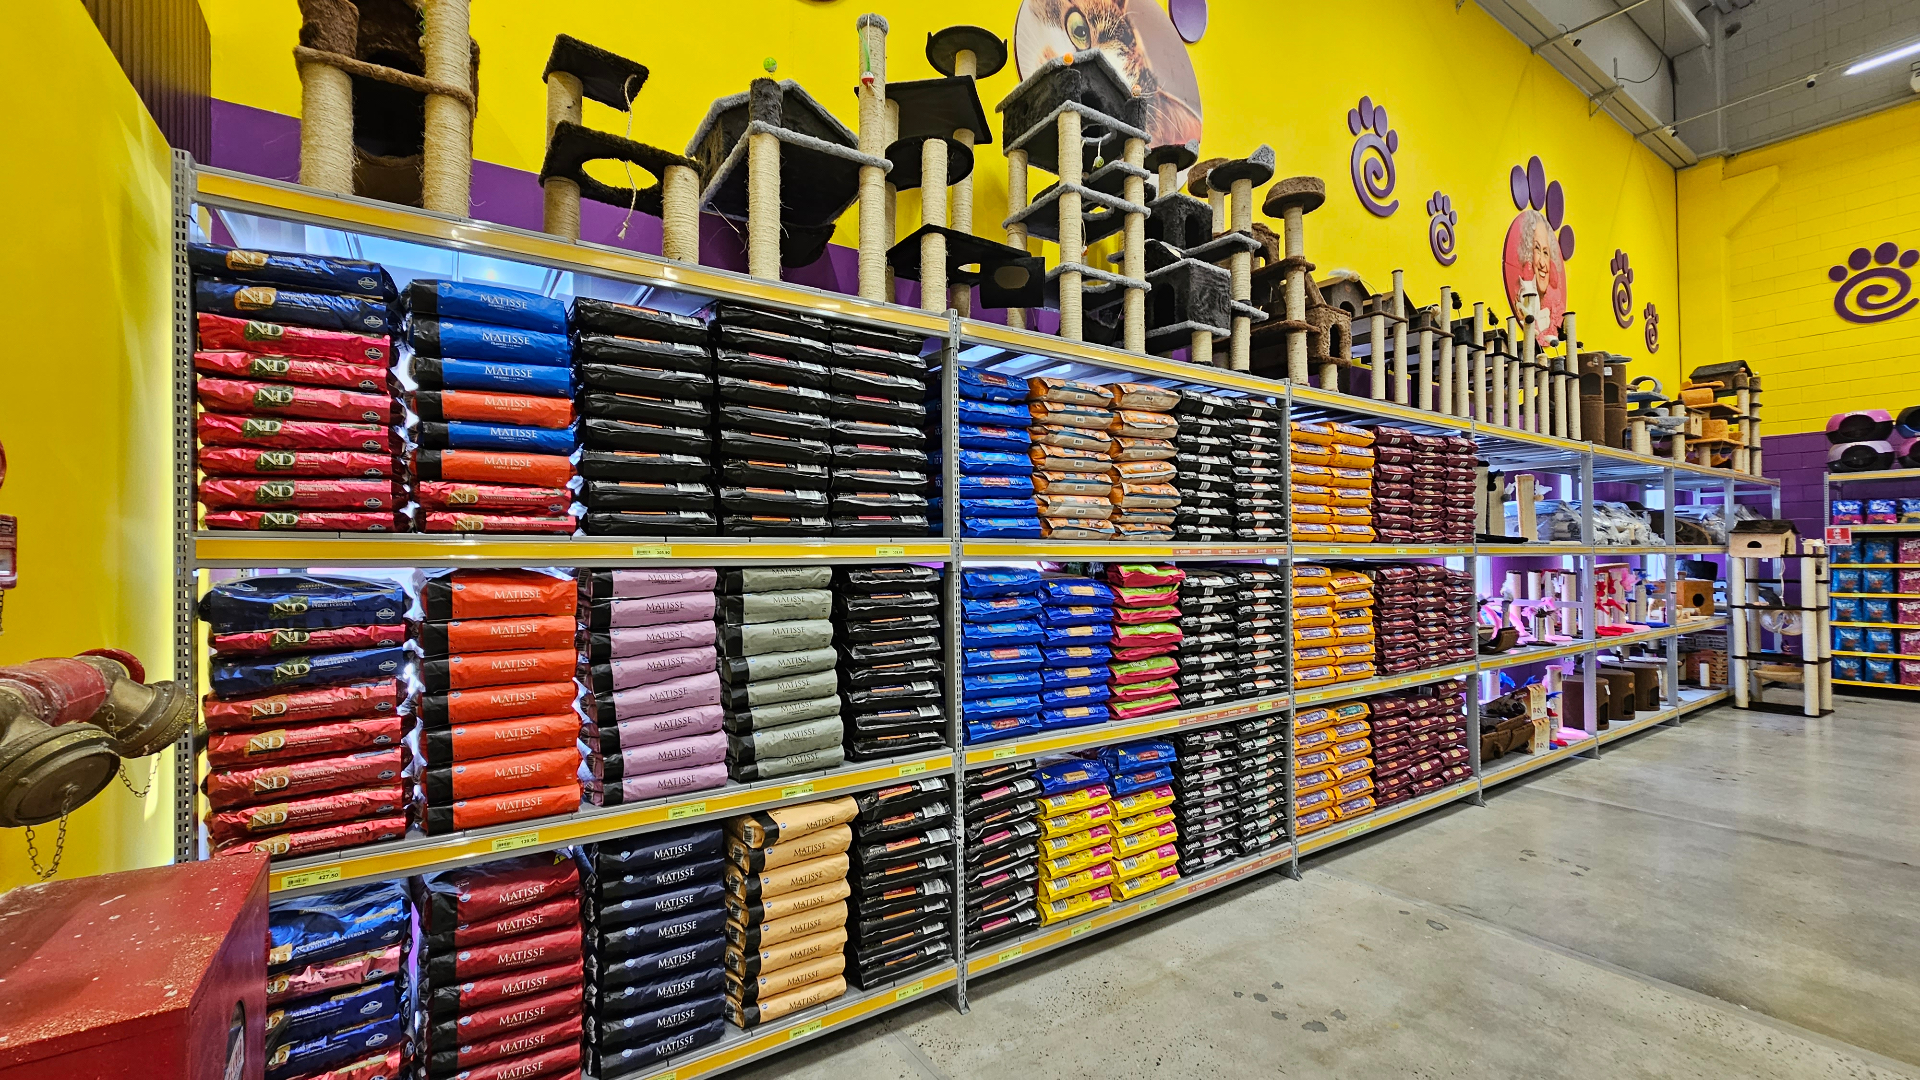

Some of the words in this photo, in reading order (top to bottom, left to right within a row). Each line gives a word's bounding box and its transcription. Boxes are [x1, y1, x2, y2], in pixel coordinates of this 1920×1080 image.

[480, 294, 528, 309] MATISSE
[482, 332, 530, 345] MATISSE
[485, 366, 532, 378] MATISSE
[484, 397, 532, 408] MATISSE
[490, 427, 538, 438] MATISSE
[484, 456, 531, 467] MATISSE
[494, 590, 541, 599] MATISSE
[646, 601, 685, 611] MATISSE
[490, 625, 538, 635] MATISSE
[646, 630, 685, 641] MATISSE
[491, 659, 538, 669] MATISSE
[646, 656, 685, 670] MATISSE
[778, 656, 810, 667] MATISSE
[490, 692, 537, 704] MATISSE
[649, 687, 688, 701] MATISSE
[653, 716, 692, 731] MATISSE
[494, 726, 541, 740] MATISSE
[658, 746, 697, 760] MATISSE
[494, 763, 542, 778] MATISSE
[657, 774, 697, 788] MATISSE
[495, 797, 543, 812] MATISSE
[654, 843, 693, 860] MATISSE
[793, 842, 827, 857] MATISSE
[656, 867, 695, 884] MATISSE
[790, 871, 824, 885] MATISSE
[499, 884, 545, 904] MATISSE
[655, 894, 694, 910] MATISSE
[792, 895, 825, 910] MATISSE
[496, 915, 543, 932] MATISSE
[658, 920, 697, 938] MATISSE
[789, 919, 822, 934] MATISSE
[498, 947, 545, 965] MATISSE
[789, 944, 822, 960] MATISSE
[658, 951, 697, 969] MATISSE
[501, 976, 548, 995] MATISSE
[787, 970, 819, 986] MATISSE
[657, 980, 695, 997] MATISSE
[788, 993, 821, 1010] MATISSE
[499, 1006, 546, 1026] MATISSE
[657, 1009, 695, 1028] MATISSE
[500, 1034, 546, 1054] MATISSE
[656, 1035, 694, 1056] MATISSE
[497, 1061, 544, 1080] MATISSE
